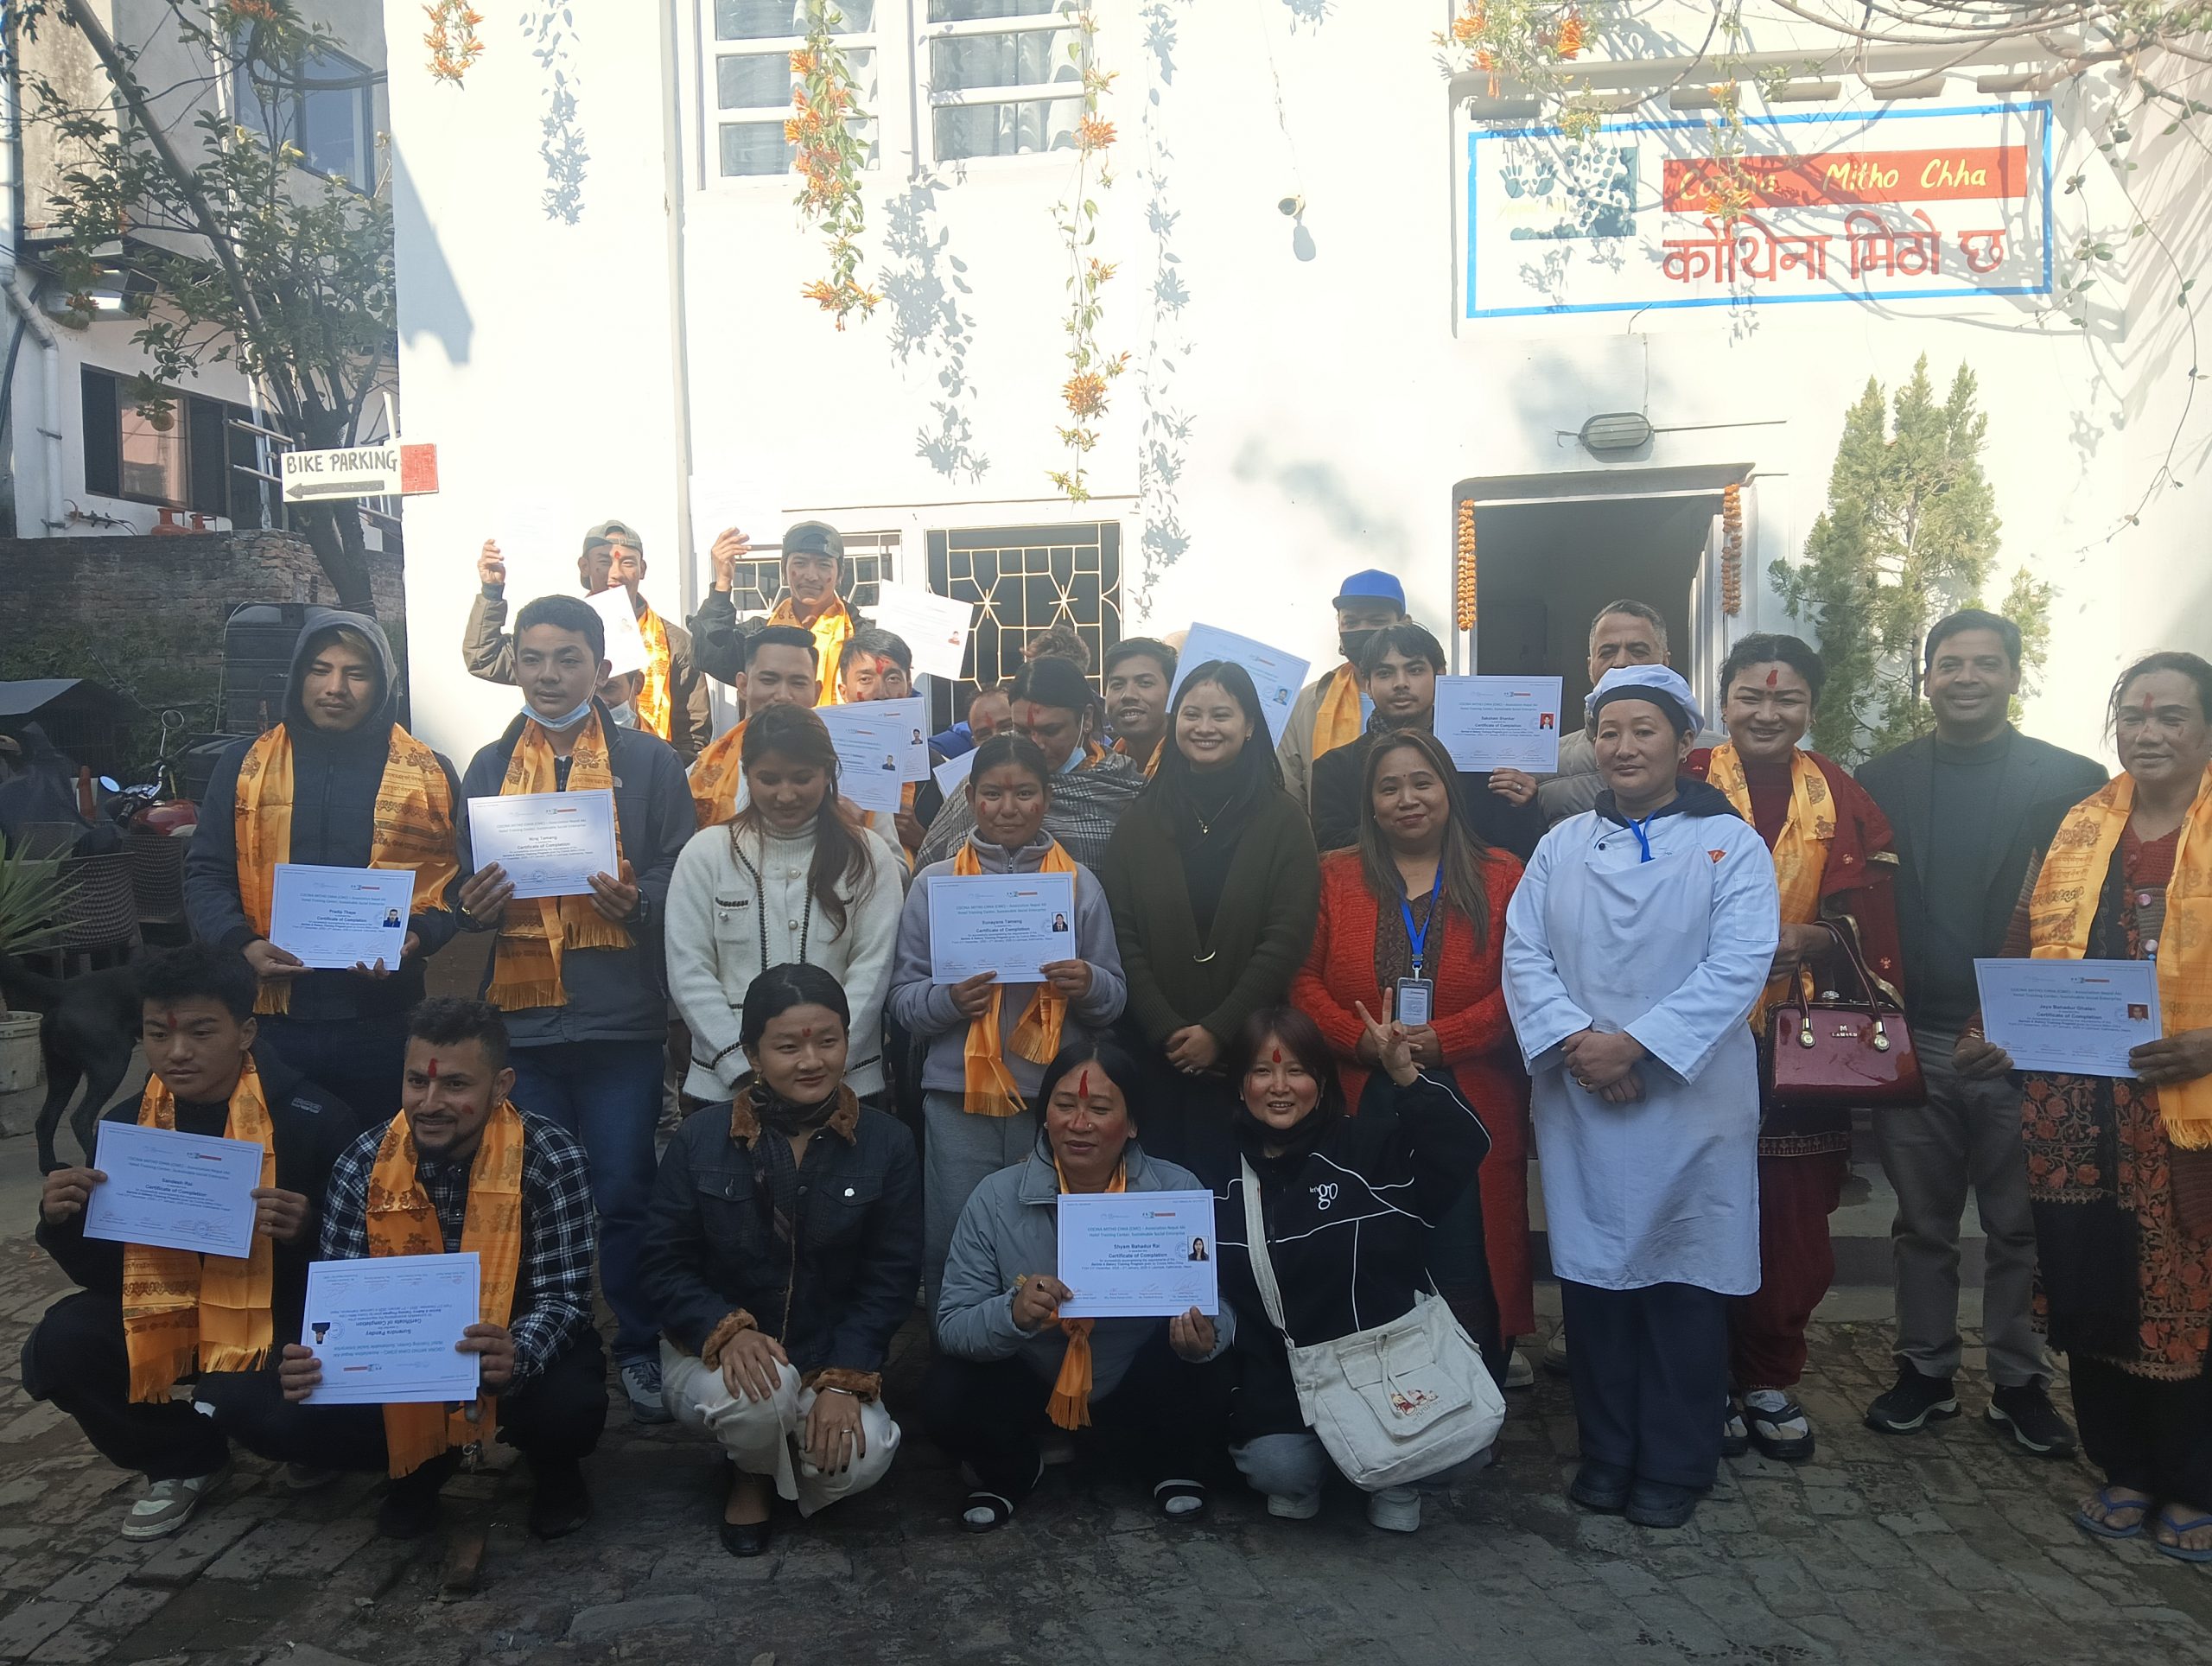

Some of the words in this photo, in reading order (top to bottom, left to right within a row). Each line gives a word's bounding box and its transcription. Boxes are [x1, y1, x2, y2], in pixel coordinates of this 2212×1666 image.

[1822, 162, 1899, 191] Mitho
[1920, 158, 1986, 188] Chha
[1844, 208, 1942, 279] मिठो
[1958, 230, 2005, 273] छ
[287, 455, 323, 474] BIKE
[330, 450, 397, 472] PARKING
[1319, 1183, 1338, 1210] go
